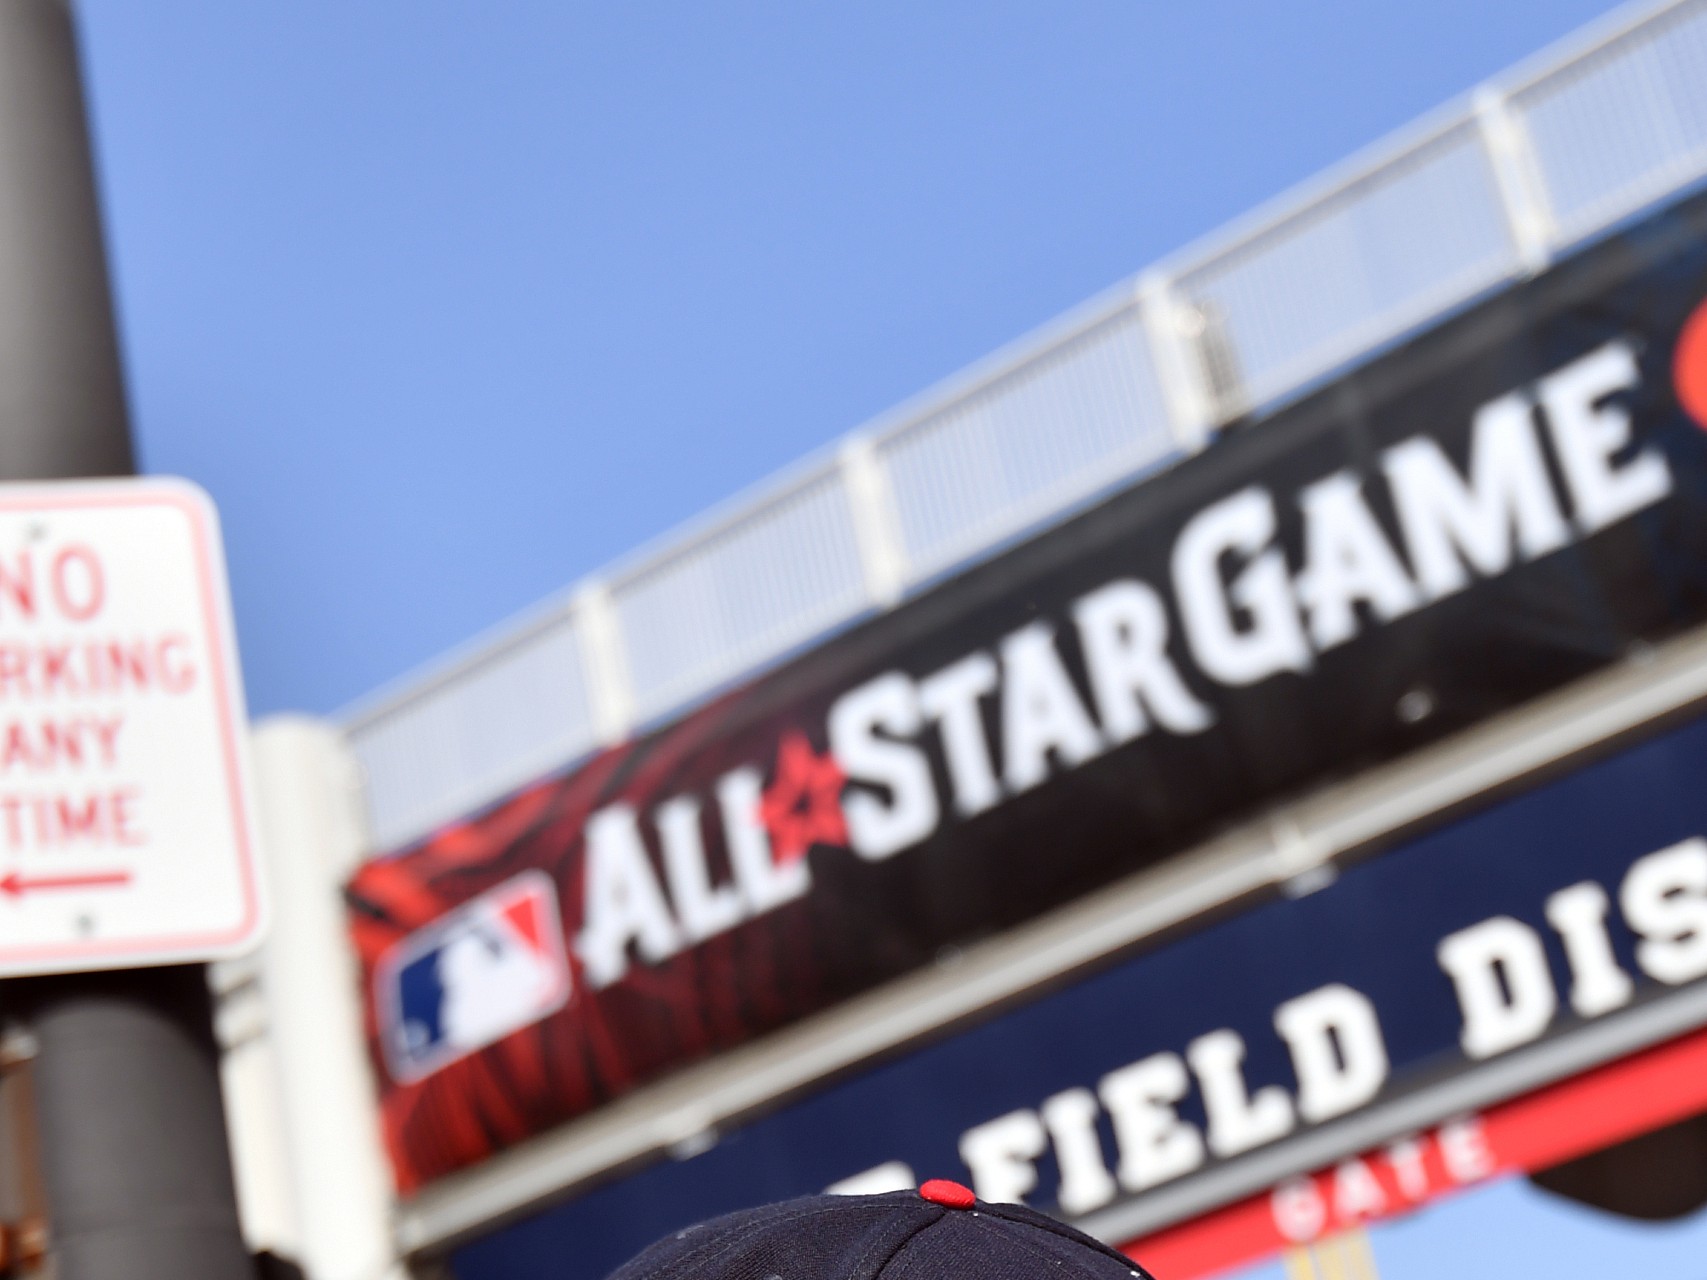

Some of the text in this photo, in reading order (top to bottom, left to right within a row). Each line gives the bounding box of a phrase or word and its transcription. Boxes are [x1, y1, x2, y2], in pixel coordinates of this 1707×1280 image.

[0, 543, 106, 622] NO
[573, 338, 1672, 990] ALL STAR GAME
[2, 714, 125, 772] ANY
[0, 788, 149, 849] TIME
[958, 836, 1707, 1213] FIELD DIS
[1270, 1115, 1496, 1242] GATE
